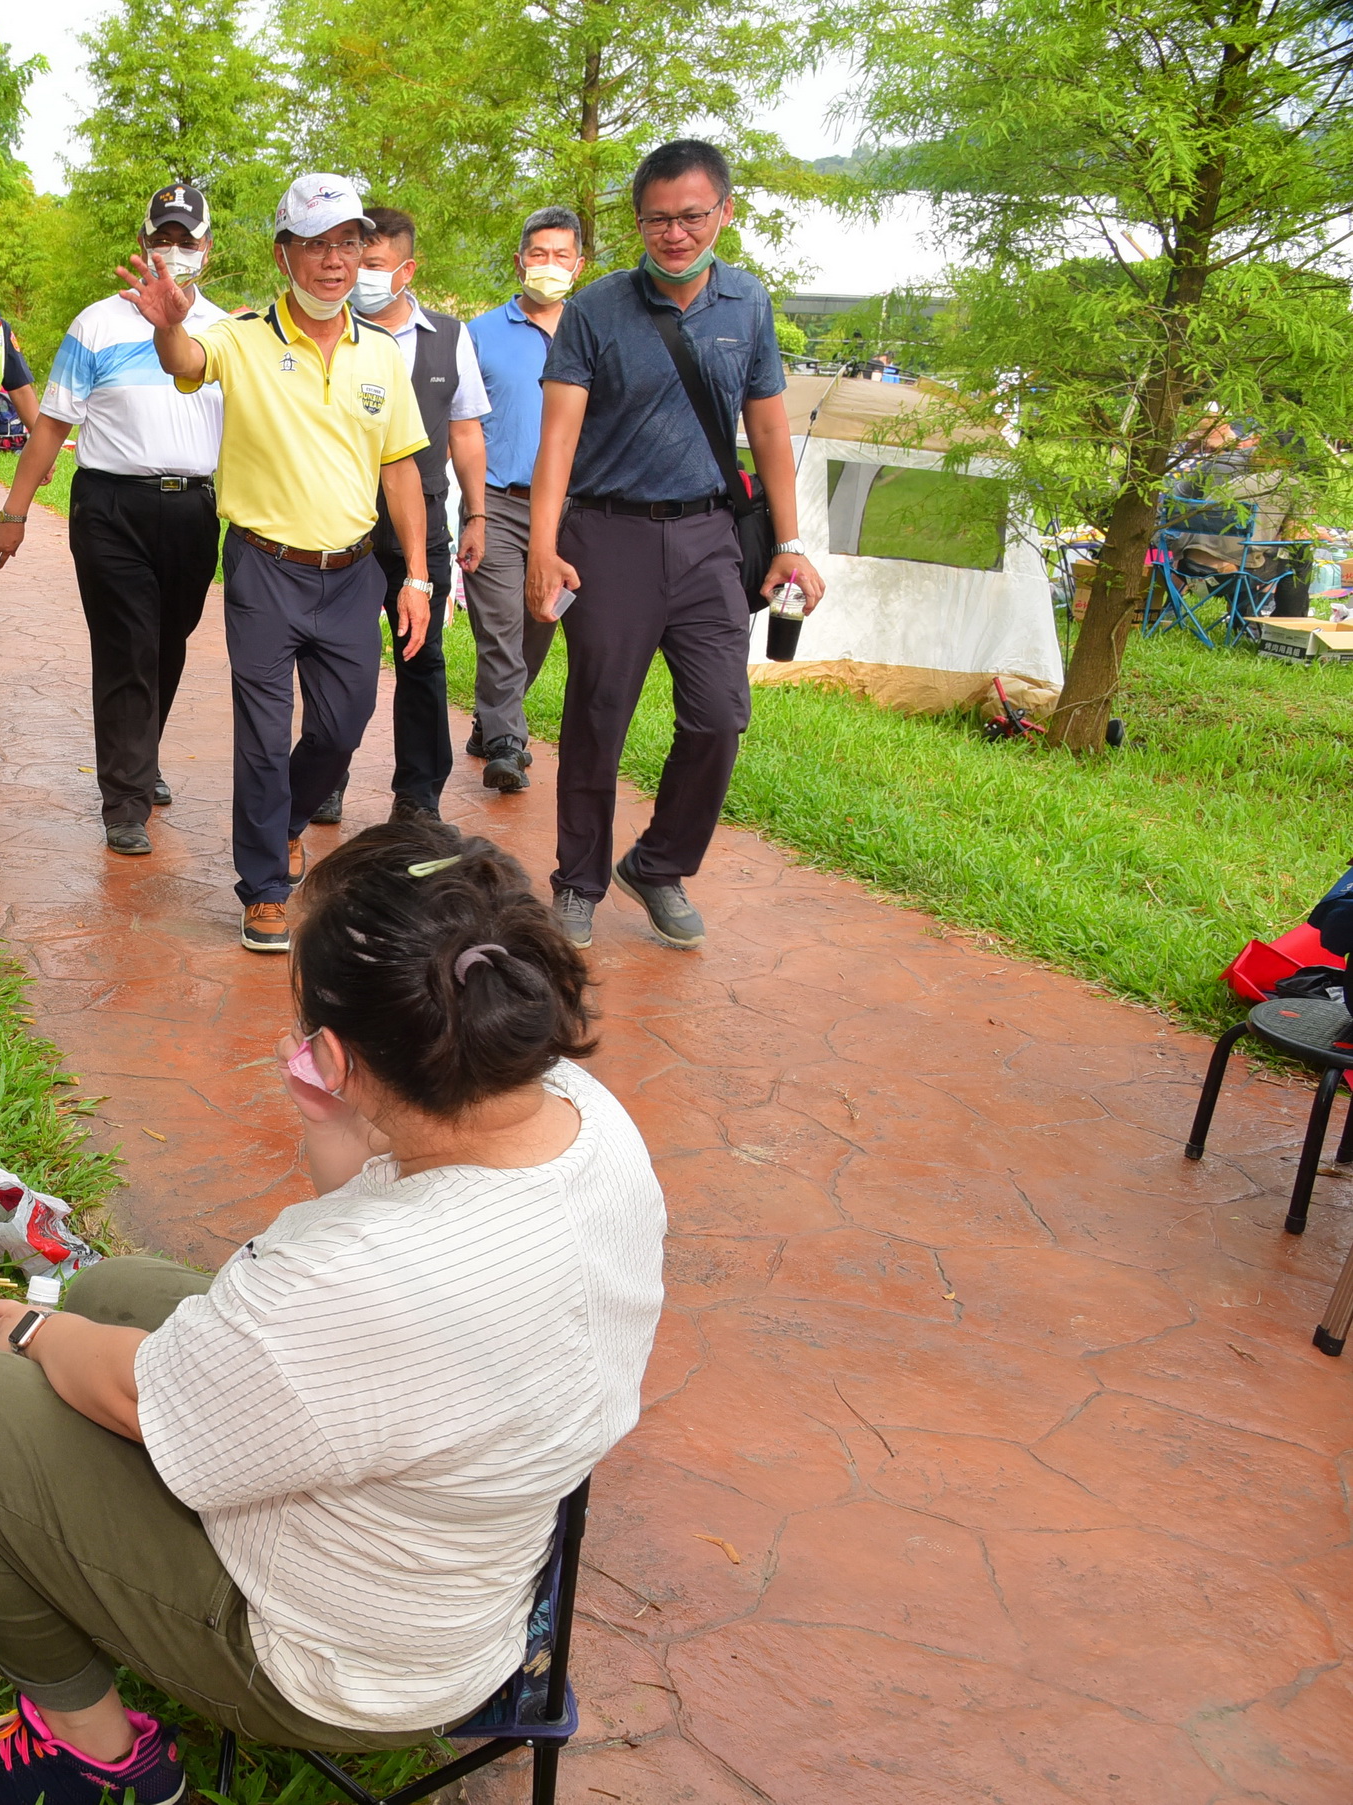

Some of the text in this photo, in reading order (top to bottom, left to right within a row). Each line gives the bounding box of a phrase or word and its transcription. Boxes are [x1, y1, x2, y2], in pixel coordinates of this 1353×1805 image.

[1264, 642, 1301, 657] 烤肉用具組
